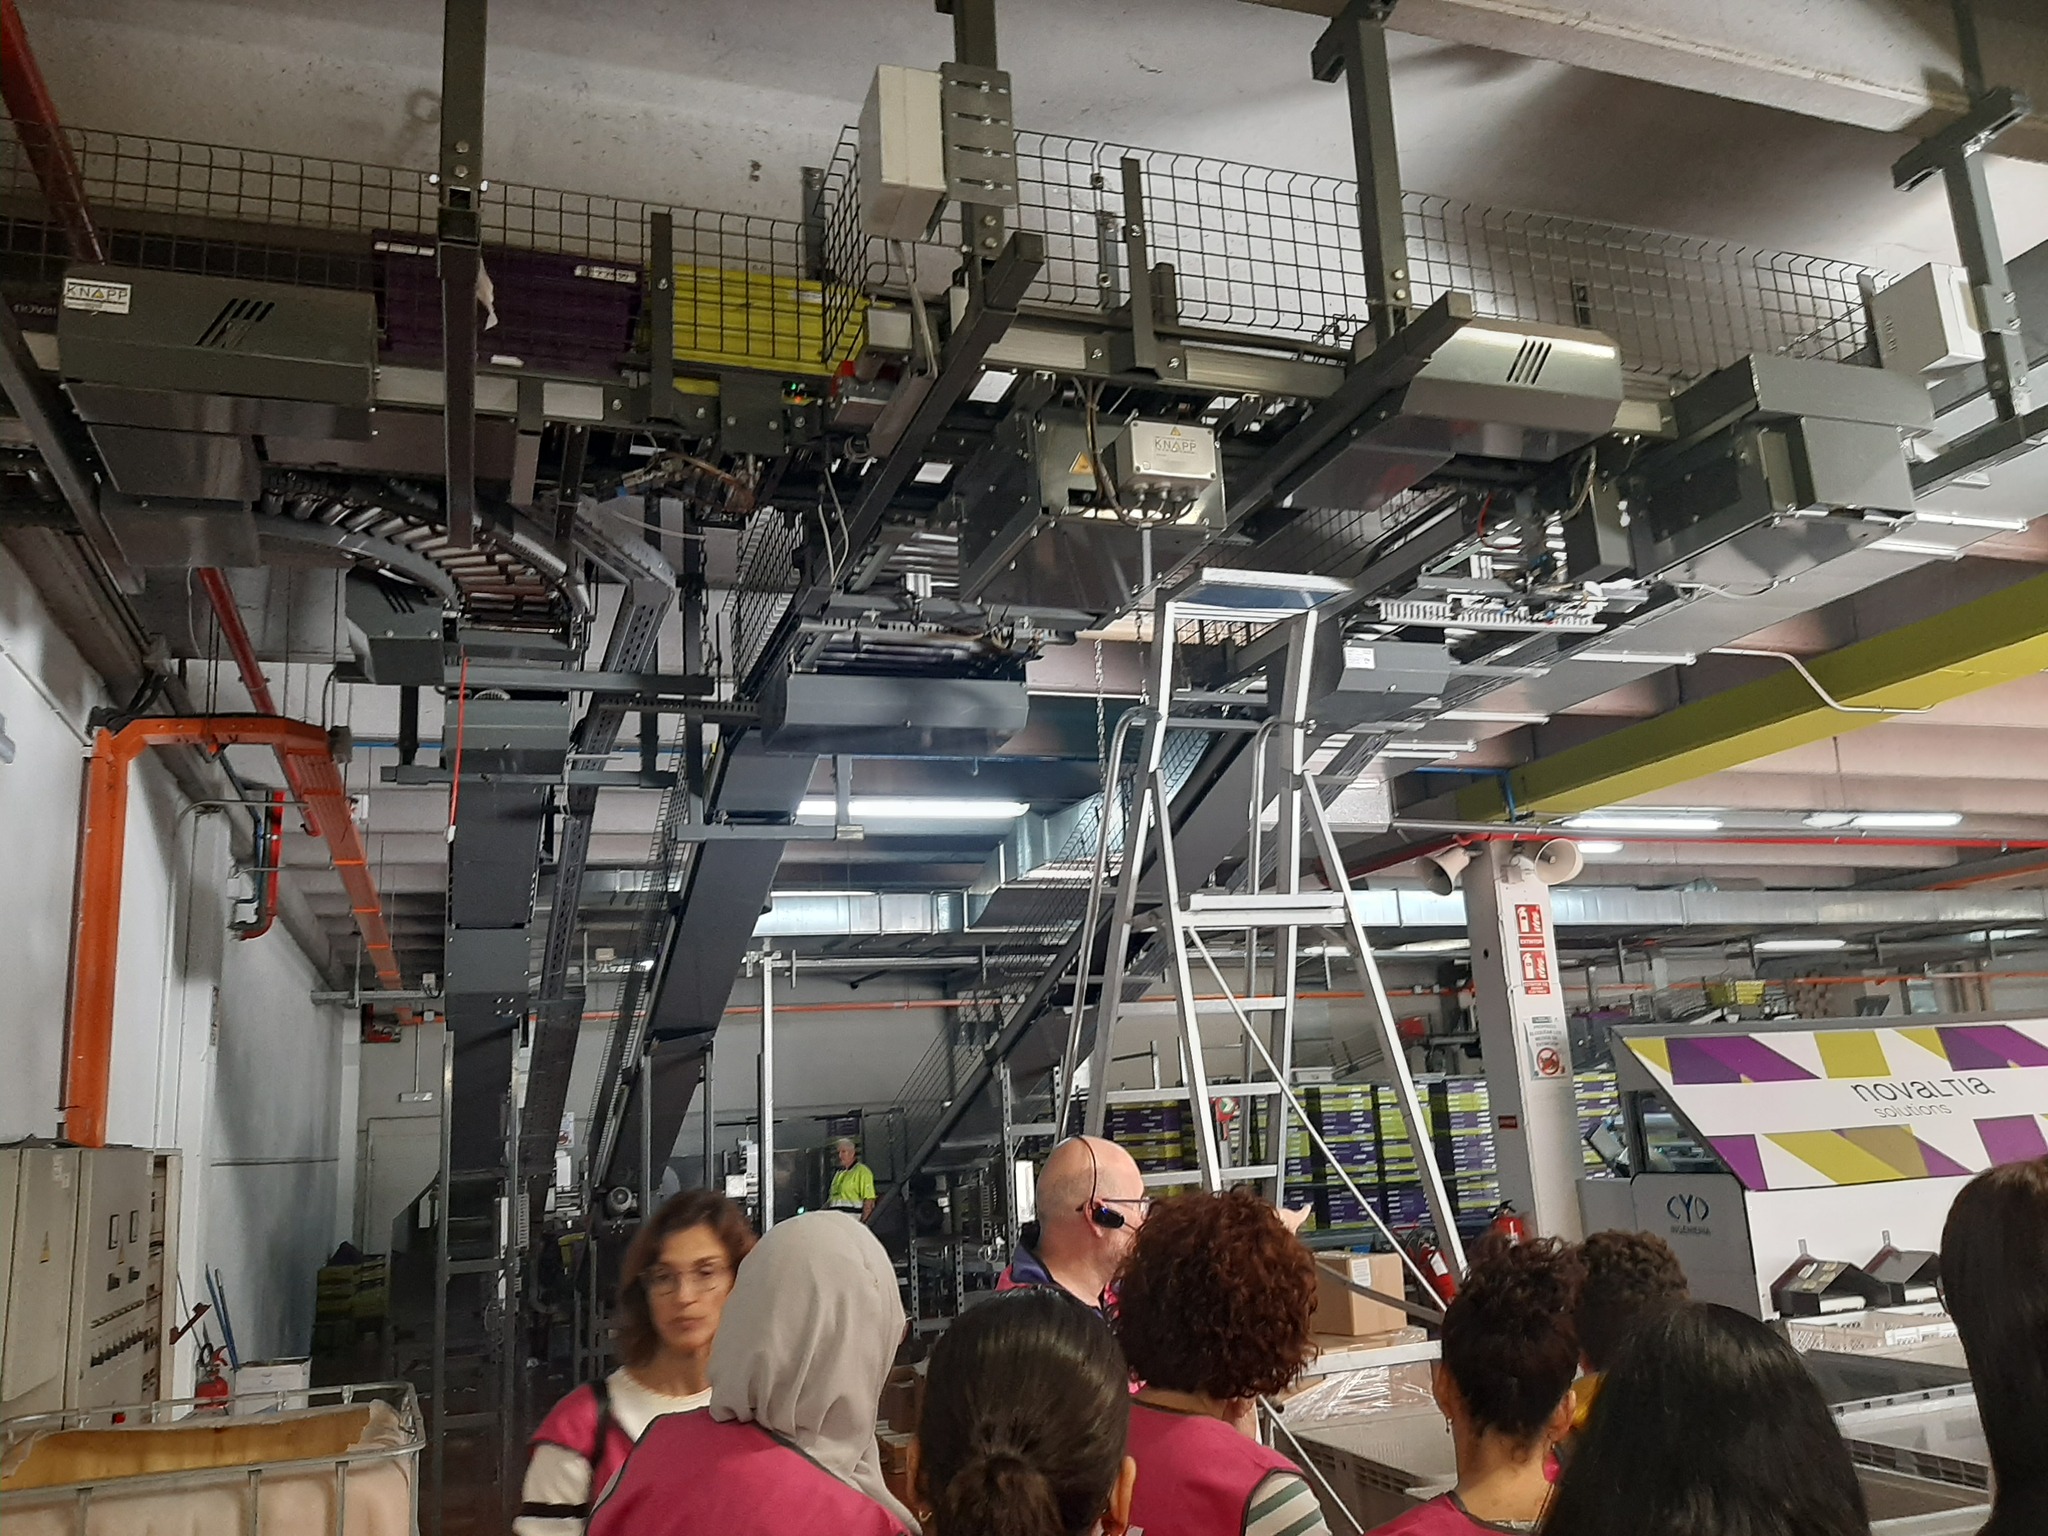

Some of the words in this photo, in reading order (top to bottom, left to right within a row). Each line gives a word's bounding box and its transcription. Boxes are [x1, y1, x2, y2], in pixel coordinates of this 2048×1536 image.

[66, 284, 128, 300] KNAPP
[1154, 438, 1197, 452] KNAPP
[1874, 1103, 1952, 1119] solutions
